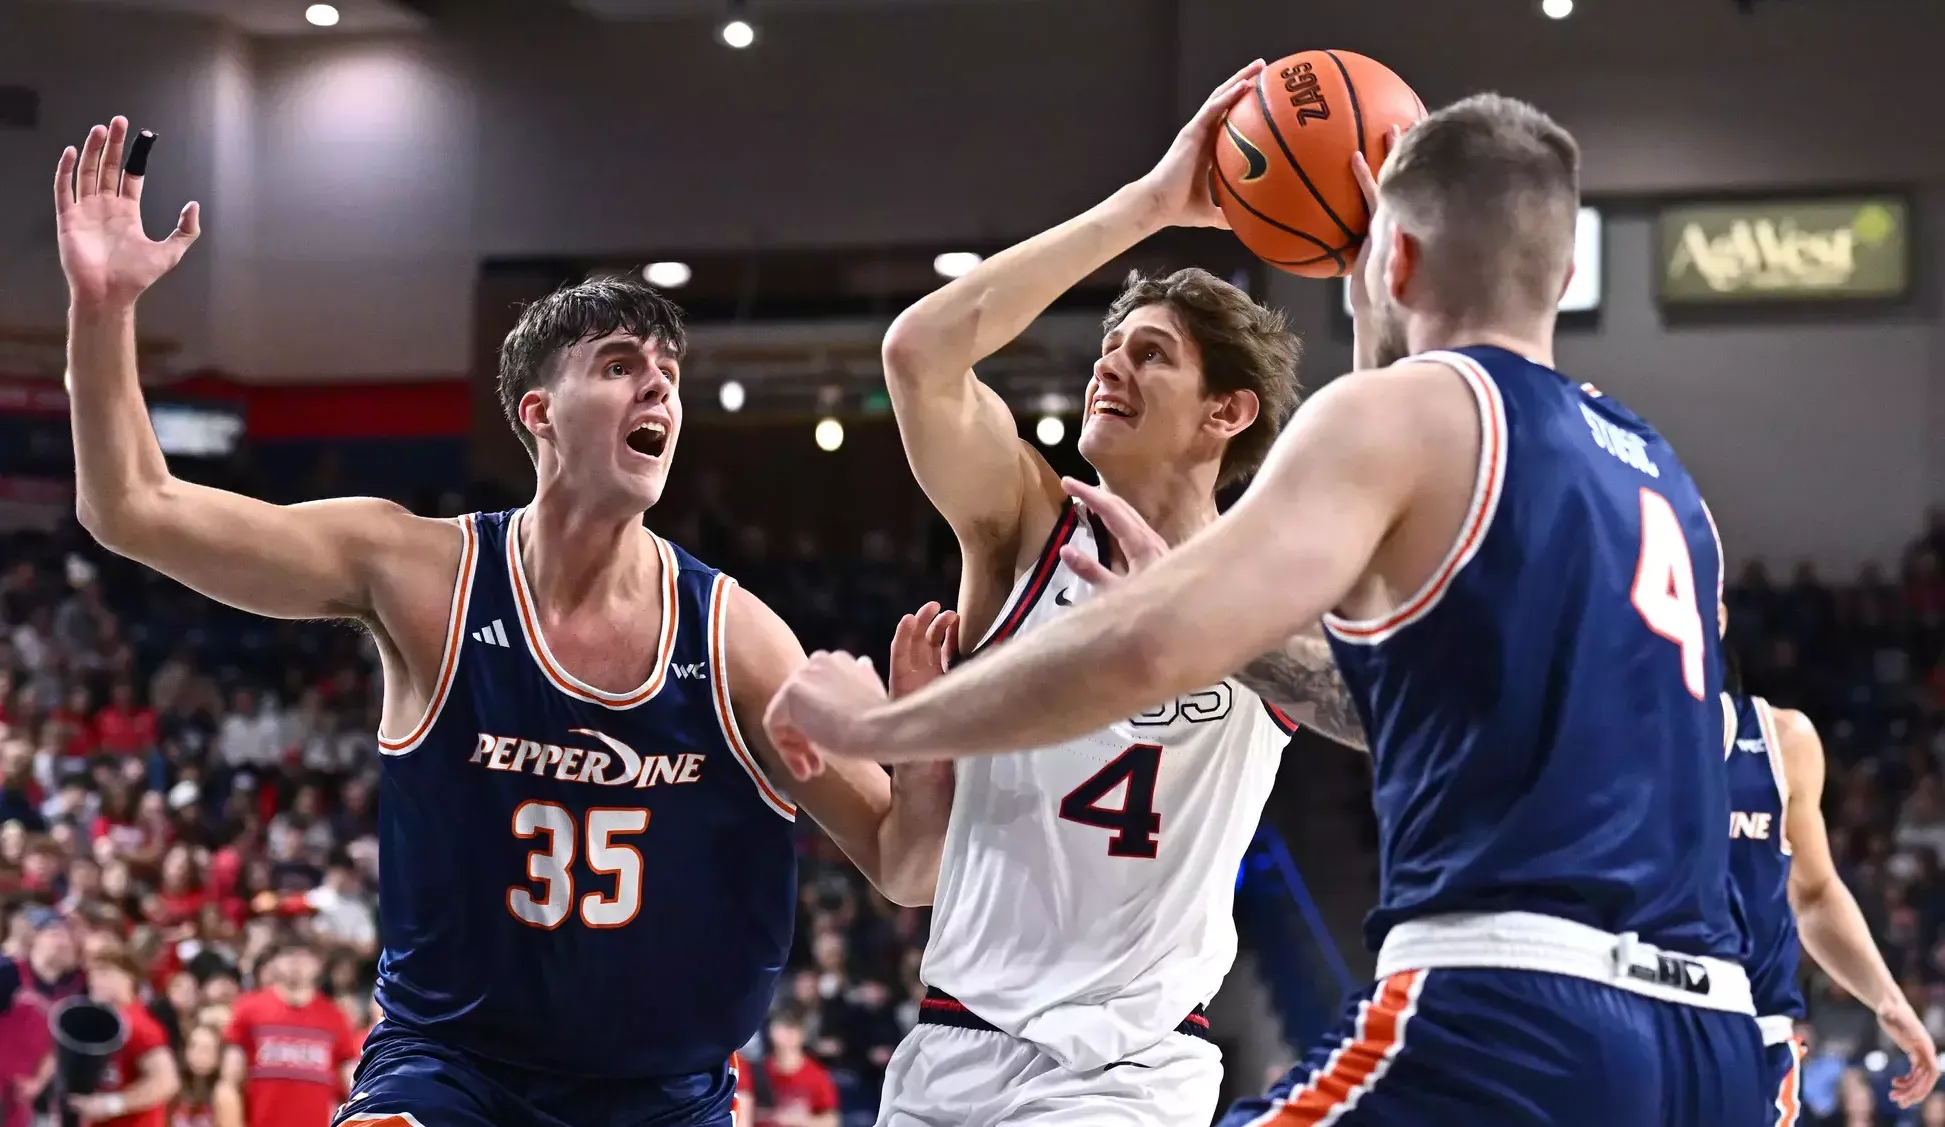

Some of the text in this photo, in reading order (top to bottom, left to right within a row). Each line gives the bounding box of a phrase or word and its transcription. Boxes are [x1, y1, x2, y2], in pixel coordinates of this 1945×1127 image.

[1281, 62, 1330, 127] ZAGS
[1630, 486, 1705, 702] 4
[468, 728, 706, 789] PEPPERDINE
[1058, 743, 1164, 859] 4
[505, 799, 651, 931] 35
